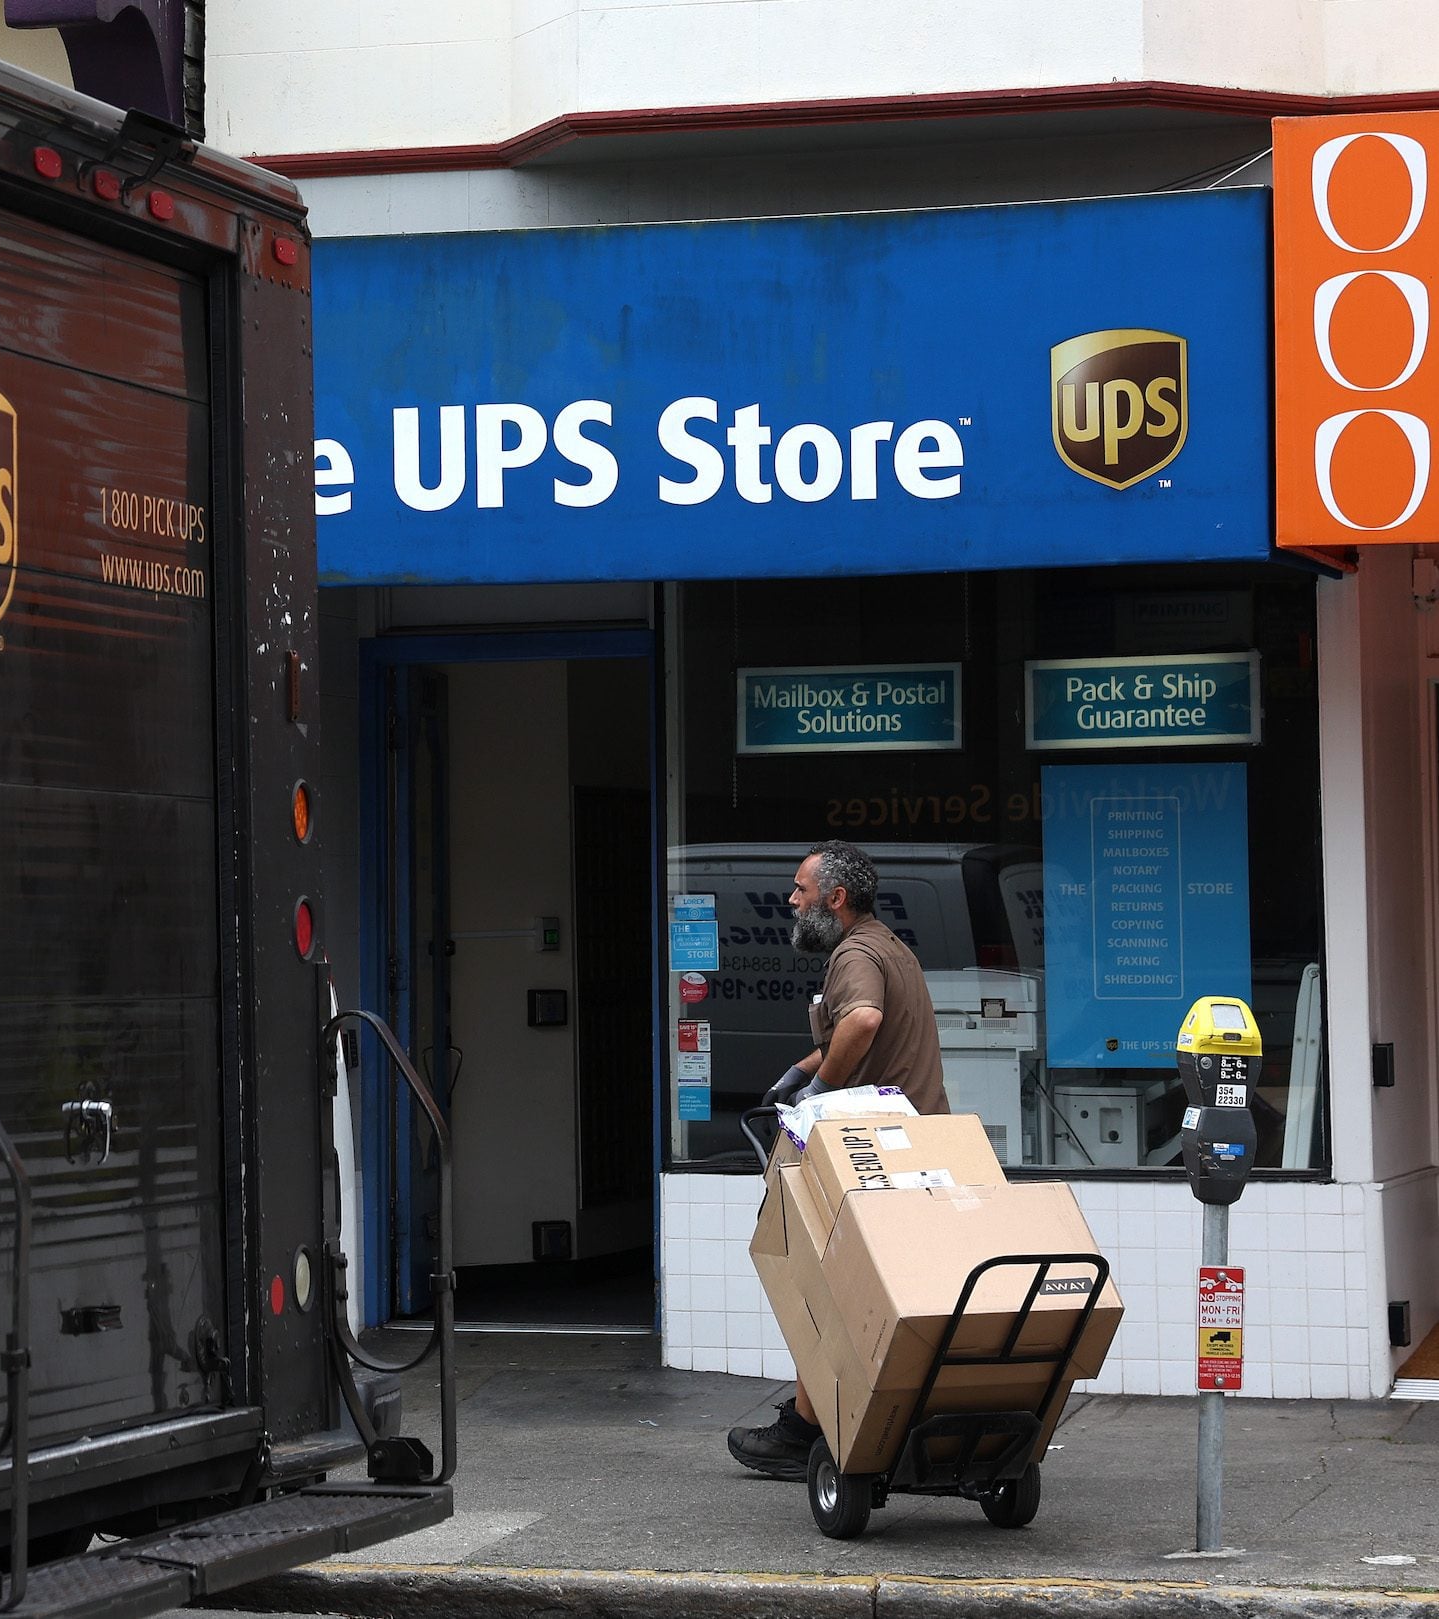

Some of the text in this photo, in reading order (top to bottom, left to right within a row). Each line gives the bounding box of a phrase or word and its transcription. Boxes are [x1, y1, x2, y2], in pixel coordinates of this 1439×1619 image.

[1062, 376, 1179, 465] ups
[393, 399, 619, 512] UPS
[111, 489, 139, 531] 800
[143, 495, 176, 538] PICK
[179, 503, 206, 544] UPS
[100, 553, 206, 602] www.ups.com
[754, 680, 946, 708] Mailbox & Postal
[1066, 672, 1217, 705] Pack & Ship
[797, 708, 902, 734] Solutions
[1076, 704, 1206, 730] Guarantee
[1107, 811, 1164, 822] PRINTING
[1107, 829, 1164, 840] SHIPPING
[1103, 847, 1170, 858] MAILBOXES
[1060, 882, 1234, 895] THE STORE
[1111, 883, 1162, 894] PACKING
[1111, 901, 1164, 912] RETURNS
[673, 925, 691, 933] THE
[1111, 919, 1164, 931] COPYING
[1107, 938, 1168, 949] SCANNING
[687, 950, 715, 959] STORE
[1117, 956, 1160, 967] FAXING
[1121, 1041, 1139, 1050] THE
[1142, 1041, 1160, 1050] UPS
[1218, 1086, 1234, 1096] 354
[1218, 1096, 1244, 1105] 22330
[842, 1136, 874, 1150] UP
[849, 1152, 884, 1172] END
[1045, 1281, 1086, 1291] AWAY
[1200, 1293, 1215, 1302] NO
[1201, 1305, 1220, 1315] MON
[1226, 1306, 1240, 1315] FRI
